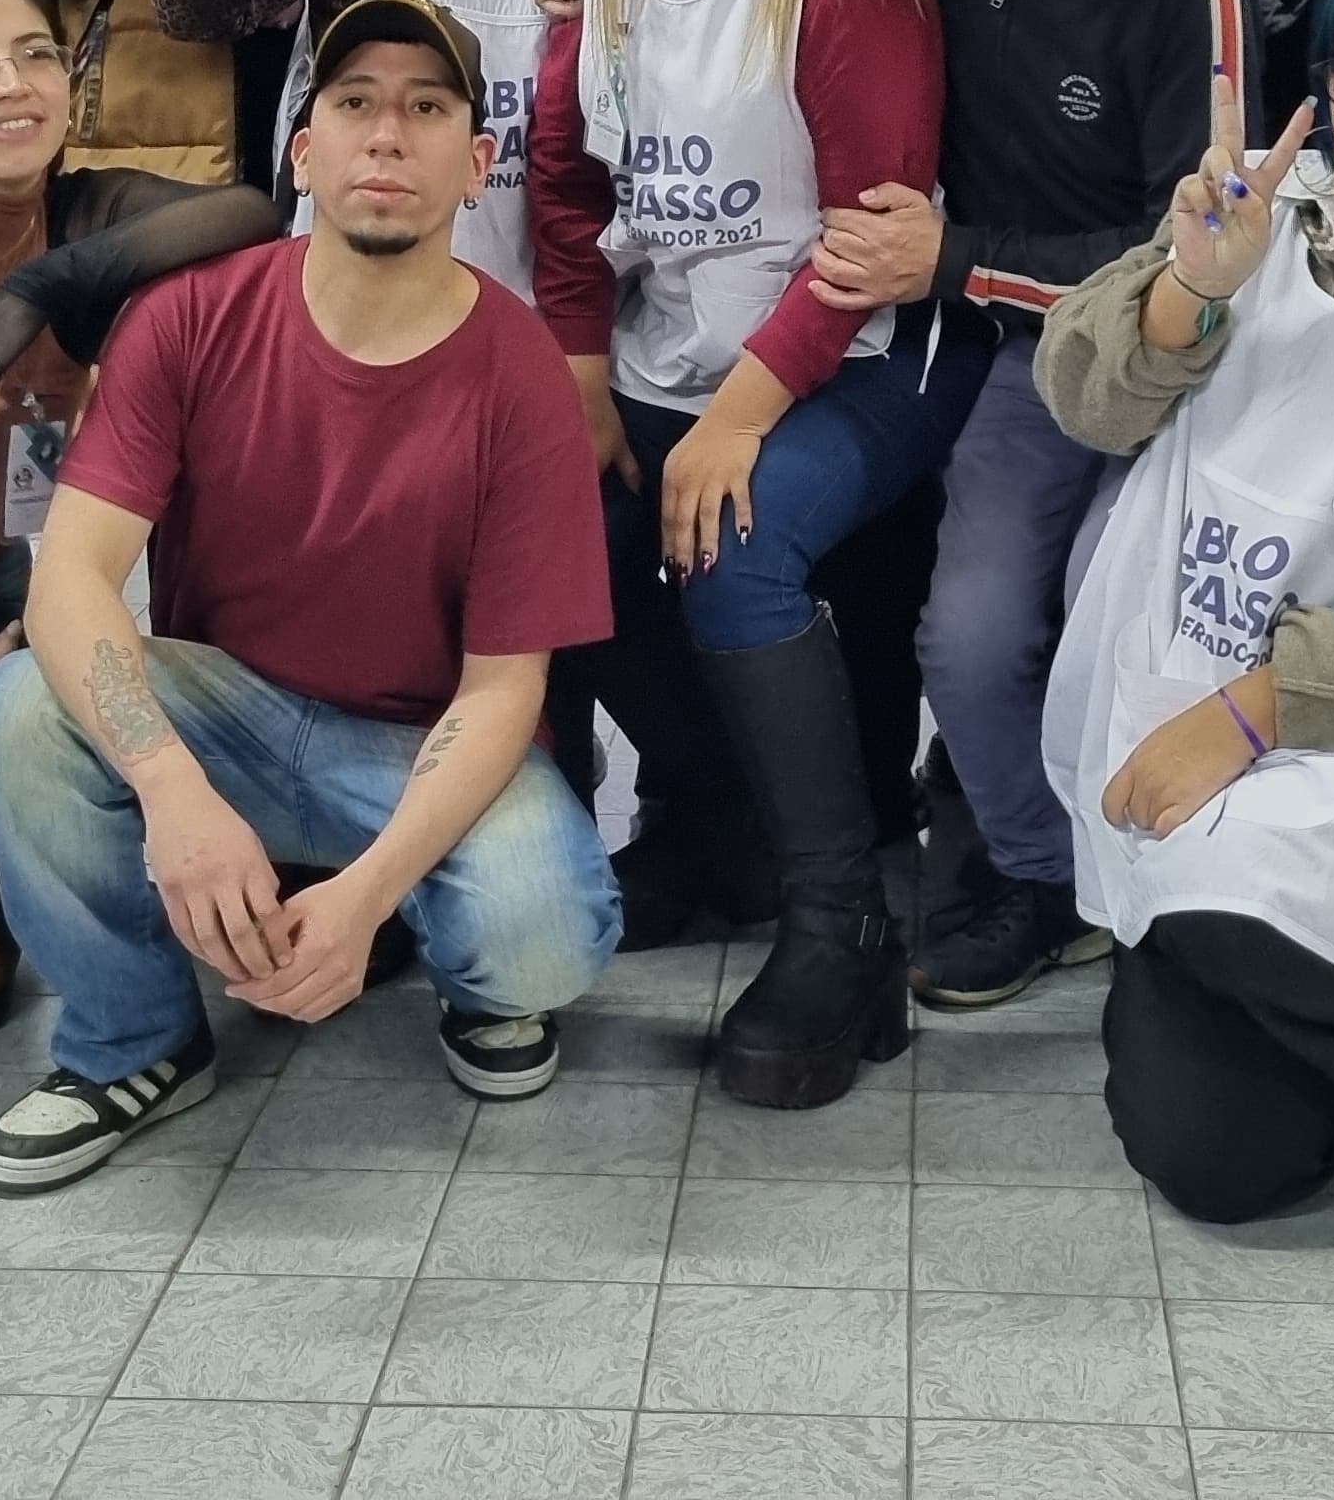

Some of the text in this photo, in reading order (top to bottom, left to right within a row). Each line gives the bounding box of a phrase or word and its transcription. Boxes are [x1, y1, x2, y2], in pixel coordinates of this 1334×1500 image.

[623, 129, 713, 176] BLO
[612, 173, 762, 223] GASSO
[714, 217, 763, 246] 2027
